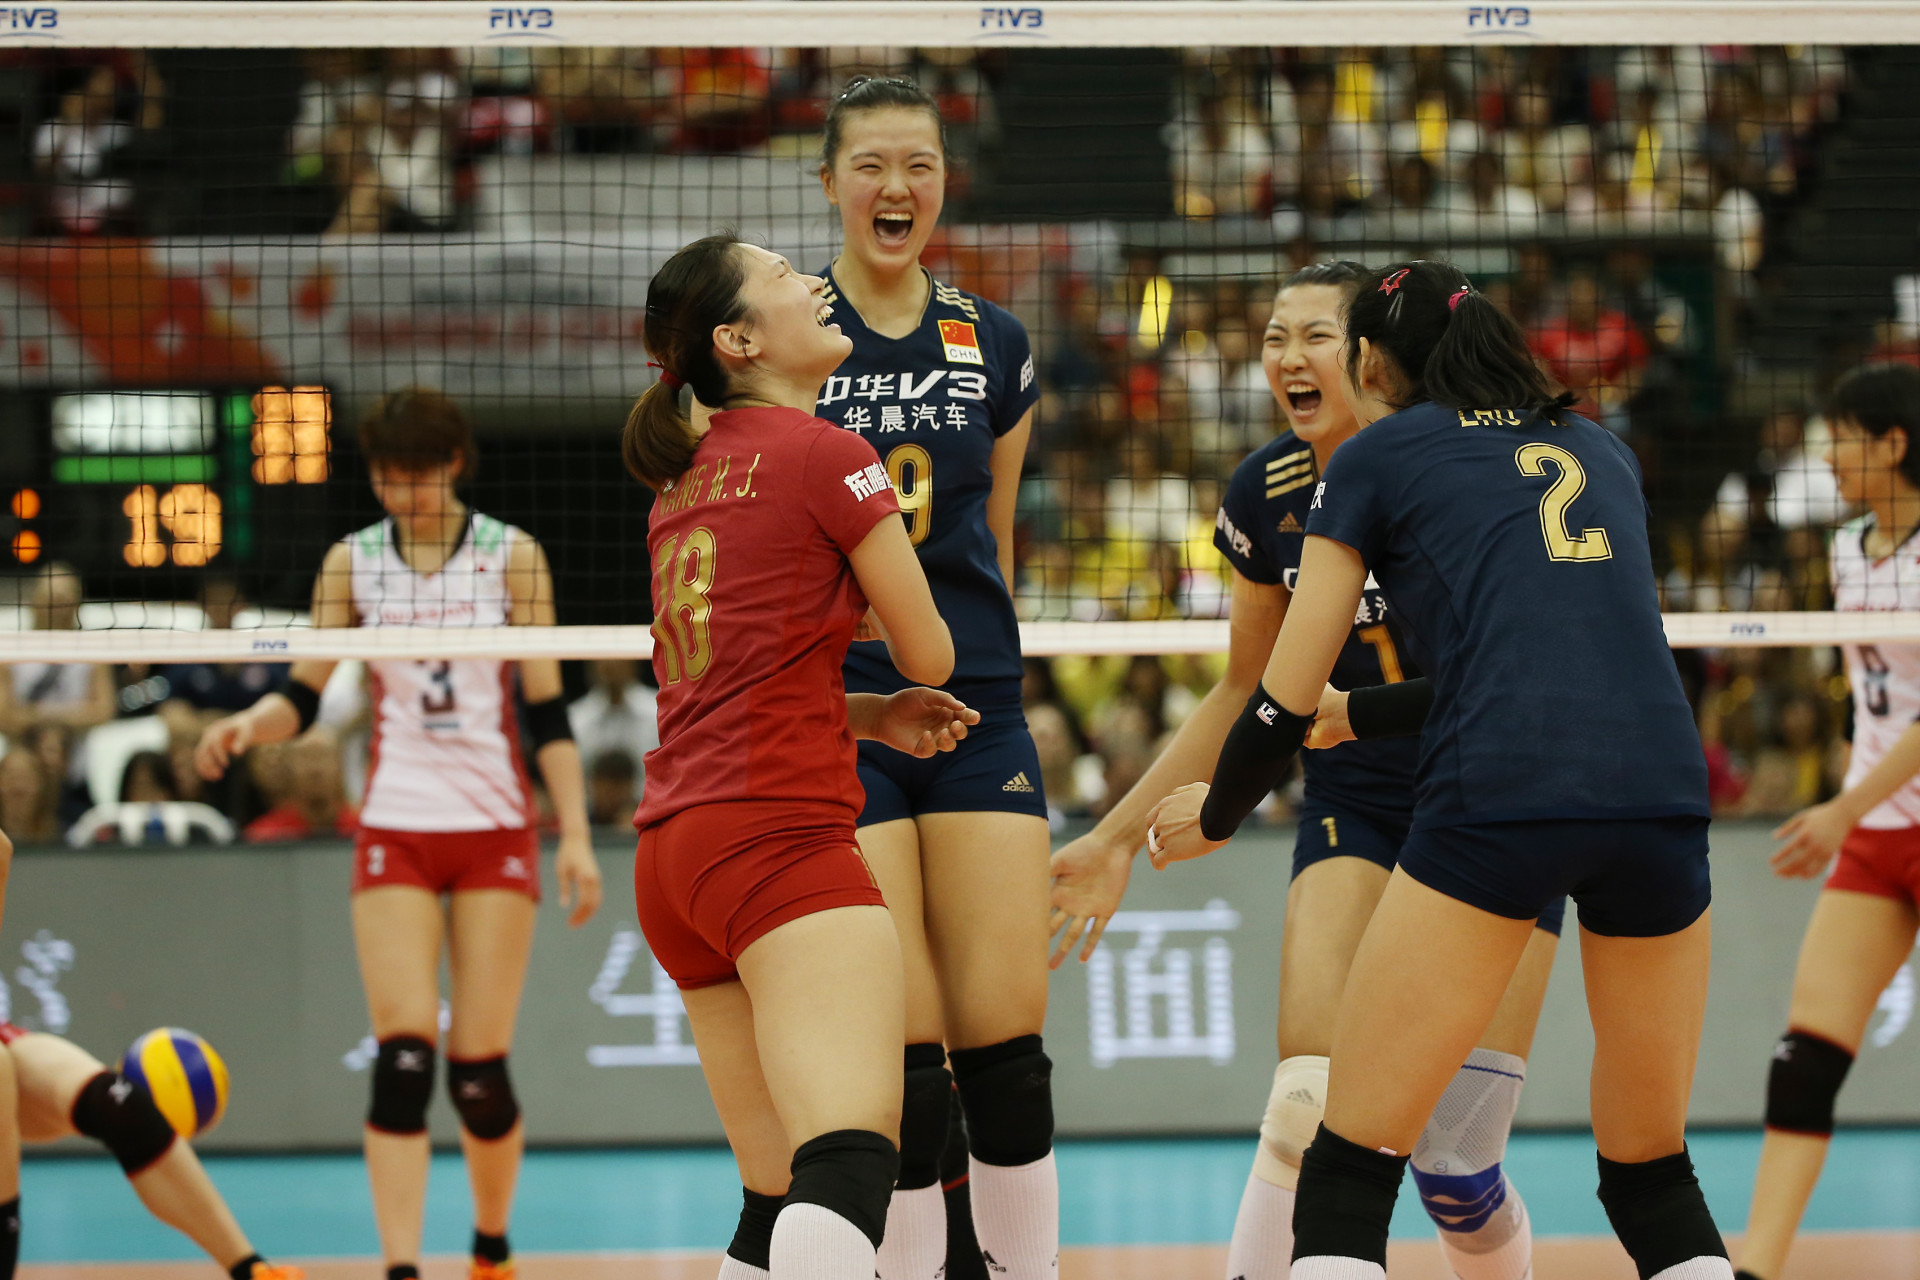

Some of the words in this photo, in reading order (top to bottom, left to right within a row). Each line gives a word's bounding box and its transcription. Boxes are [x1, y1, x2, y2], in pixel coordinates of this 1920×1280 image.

[949, 348, 978, 360] CHN
[843, 402, 969, 434] 华晨汽车
[736, 453, 761, 498] J.
[885, 443, 933, 550] 9
[1514, 442, 1613, 563] 2
[657, 527, 717, 685] 18
[1321, 816, 1339, 848] 1
